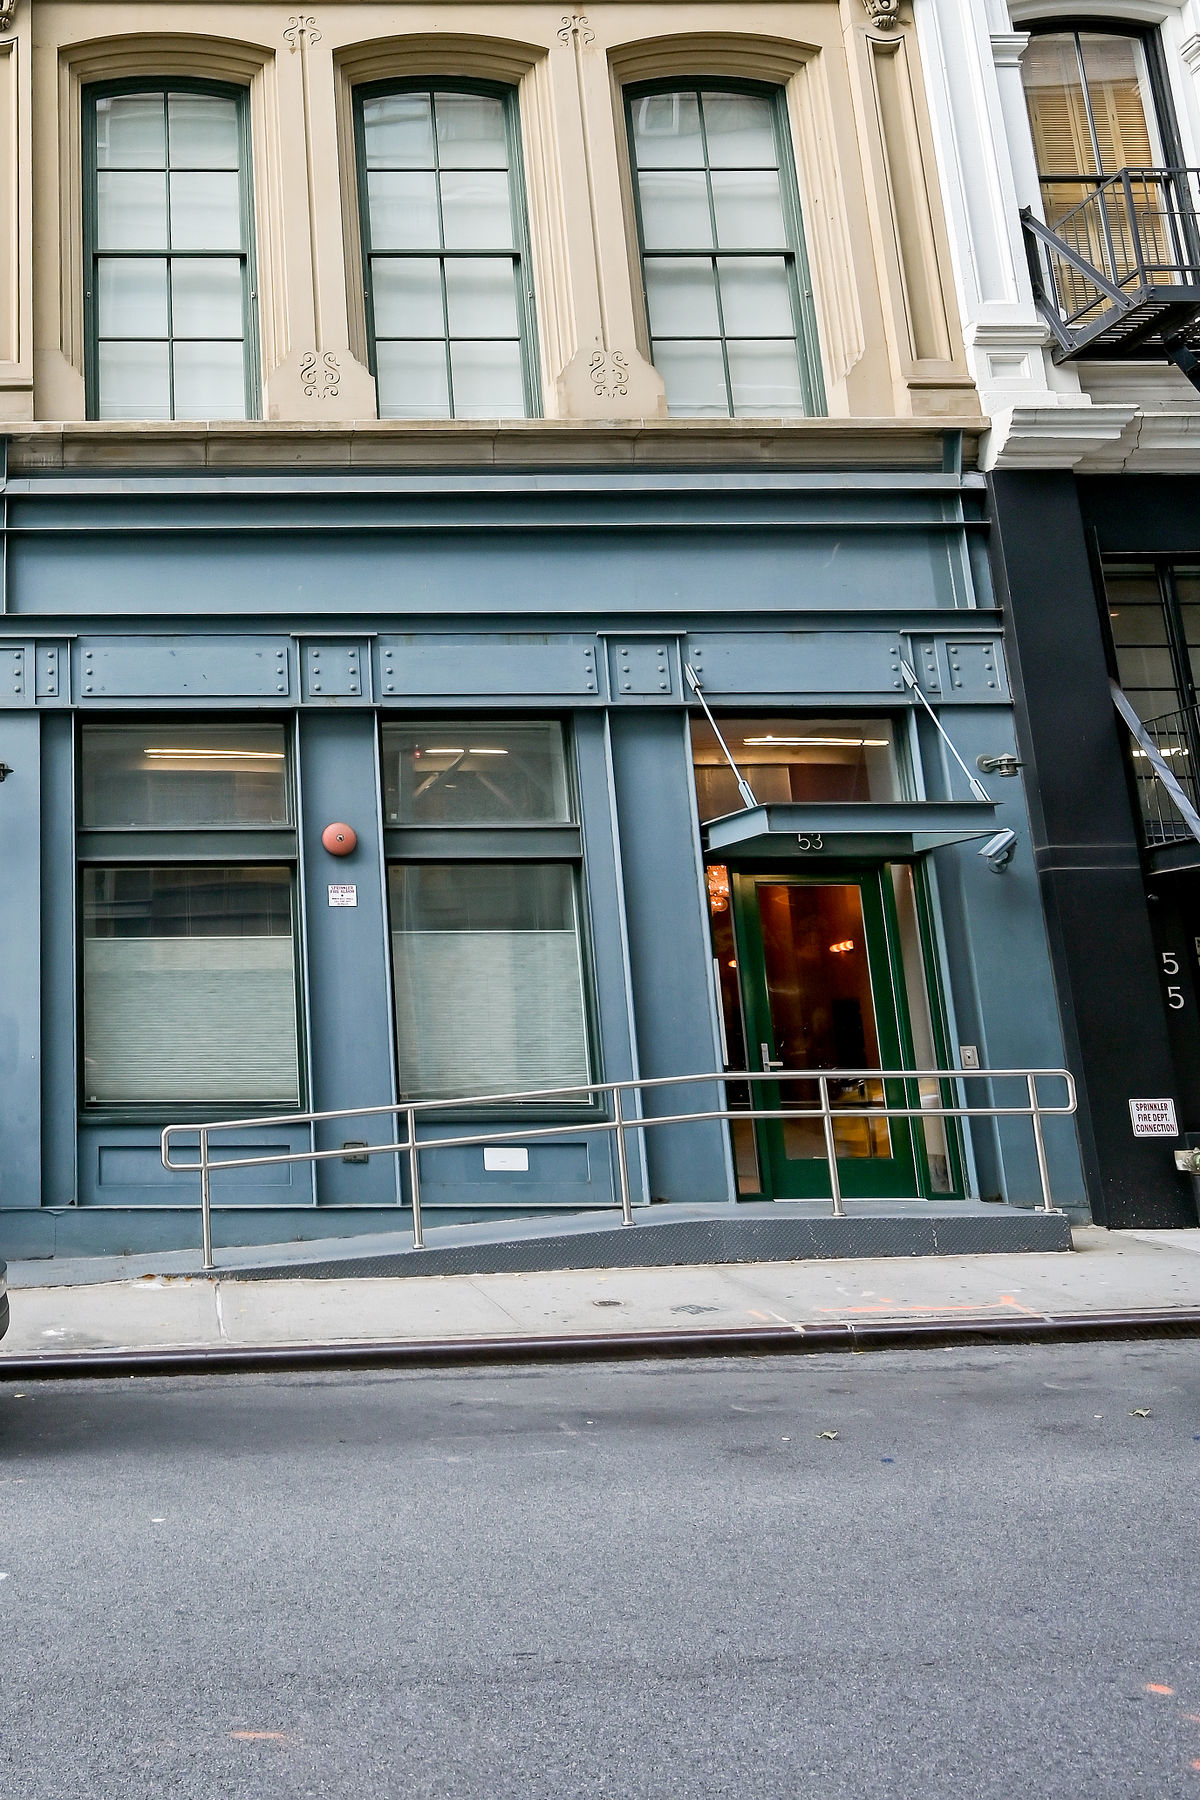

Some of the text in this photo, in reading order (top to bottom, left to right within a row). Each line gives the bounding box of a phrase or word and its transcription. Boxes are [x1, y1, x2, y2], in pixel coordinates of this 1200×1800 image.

[798, 833, 823, 850] 53
[1135, 1102, 1169, 1111] SPRINKLER
[1137, 1113, 1170, 1122] FIRE DEPT.
[1135, 1123, 1175, 1133] CONNECTION
